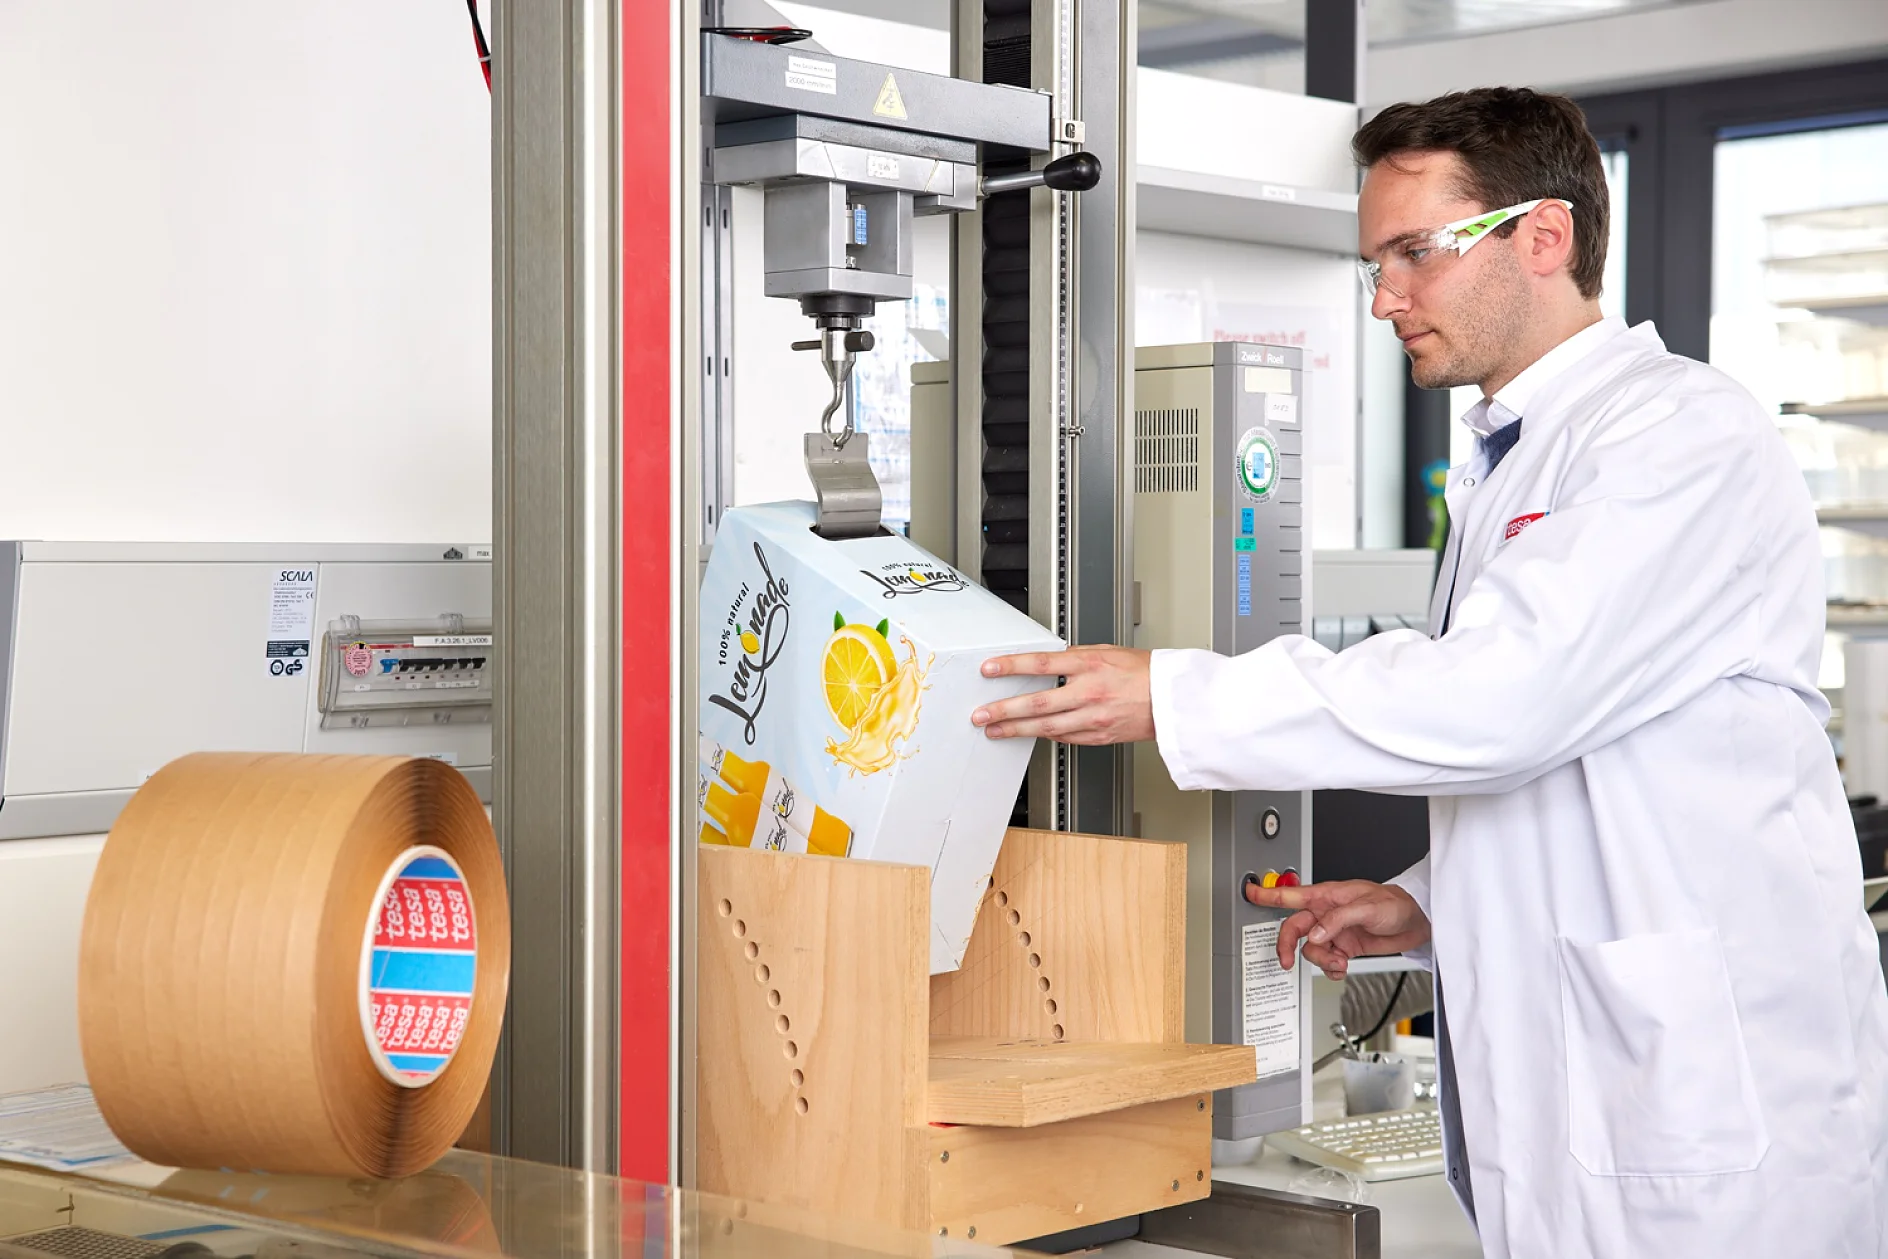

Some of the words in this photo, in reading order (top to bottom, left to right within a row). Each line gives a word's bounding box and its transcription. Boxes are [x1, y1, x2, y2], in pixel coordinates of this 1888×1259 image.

[1240, 351, 1262, 363] Zwick
[1267, 354, 1285, 365] Roell
[1253, 331, 1287, 343] switch
[1292, 331, 1307, 345] off
[279, 570, 313, 582] SCALA
[859, 566, 970, 600] Lemonade
[903, 561, 933, 569] natural
[709, 541, 790, 746] Lemonade
[718, 629, 731, 666] 100%
[727, 582, 750, 626] natural
[403, 886, 427, 942] tesa
[424, 887, 450, 943] tesa
[446, 888, 470, 944] tesa
[387, 1004, 417, 1049] tesa
[404, 1005, 434, 1050] tesa
[422, 1005, 452, 1051] tesa
